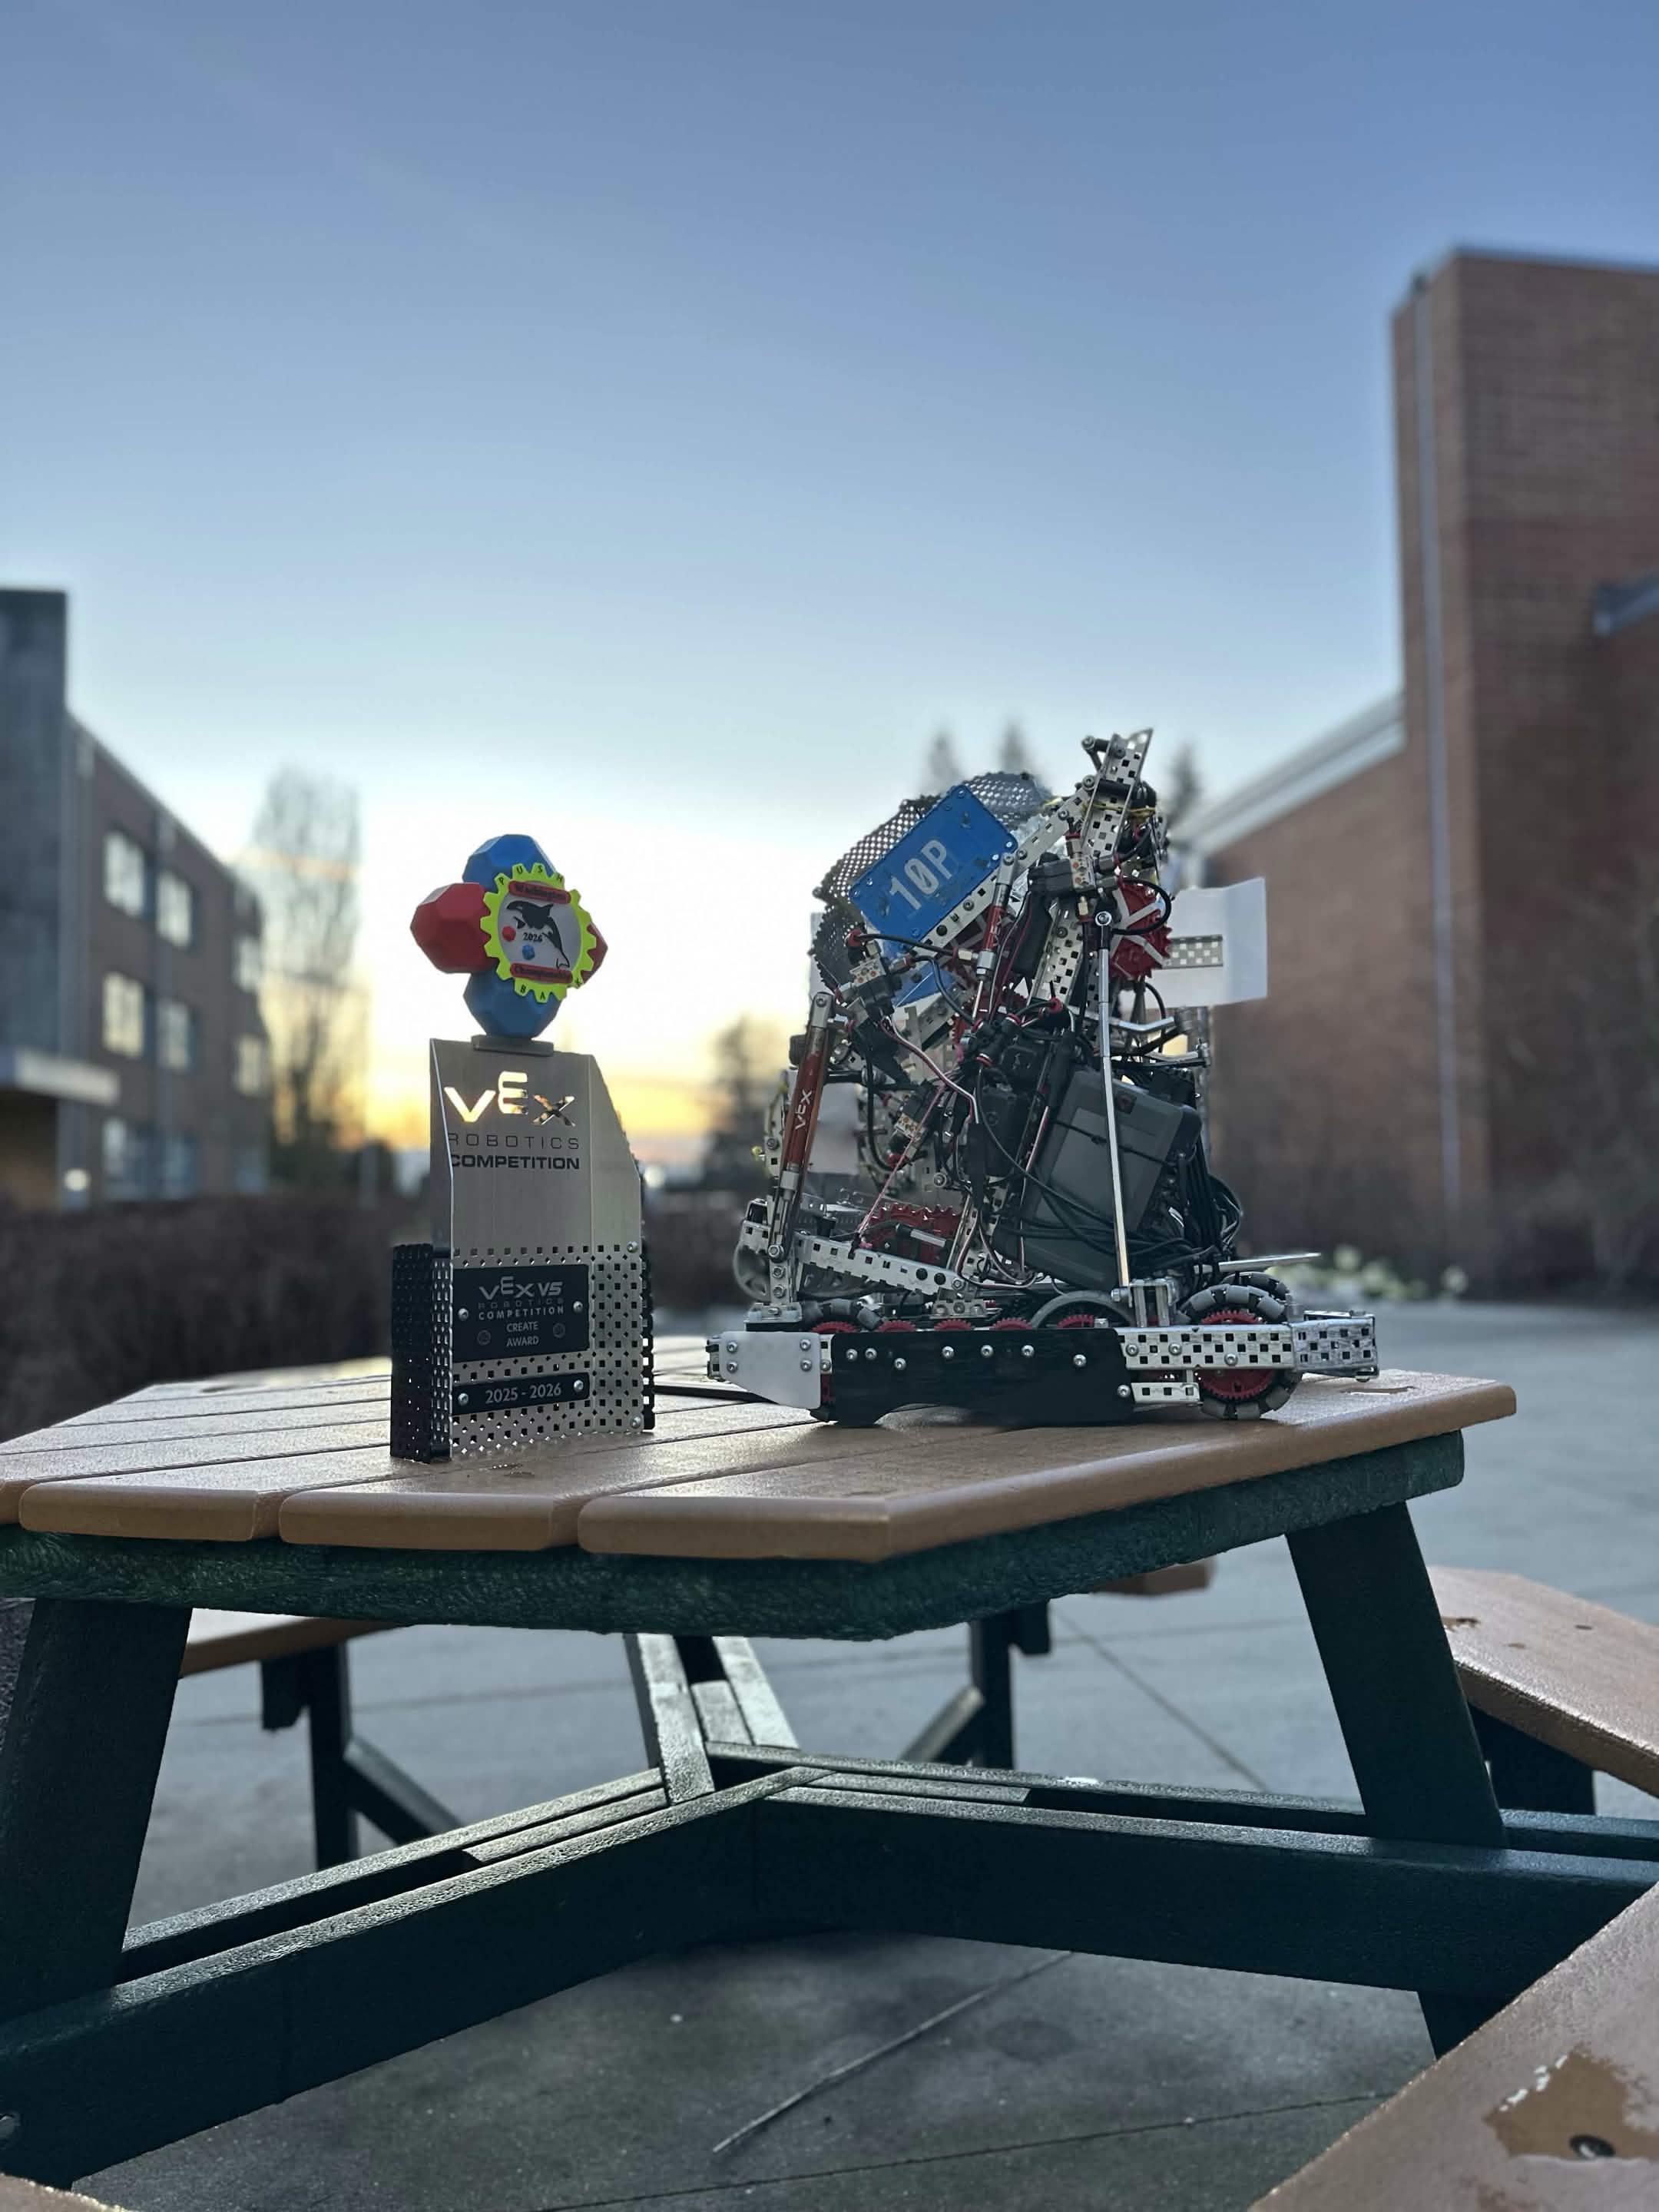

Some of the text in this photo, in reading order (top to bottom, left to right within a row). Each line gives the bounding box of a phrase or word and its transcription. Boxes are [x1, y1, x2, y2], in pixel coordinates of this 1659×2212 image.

[889, 839, 953, 910] 10P
[523, 932, 543, 943] 2026
[444, 1071, 576, 1127] VEX
[795, 1088, 813, 1131] VEX
[448, 1132, 580, 1150] ROBOTICS
[452, 1154, 580, 1170] COMPETITION
[478, 1276, 535, 1300] VEX
[478, 1306, 565, 1320] COMPETITION
[506, 1321, 538, 1333] CREATE
[506, 1335, 539, 1348] AWARD
[485, 1387, 518, 1404] 2025
[529, 1382, 561, 1399] 2026
